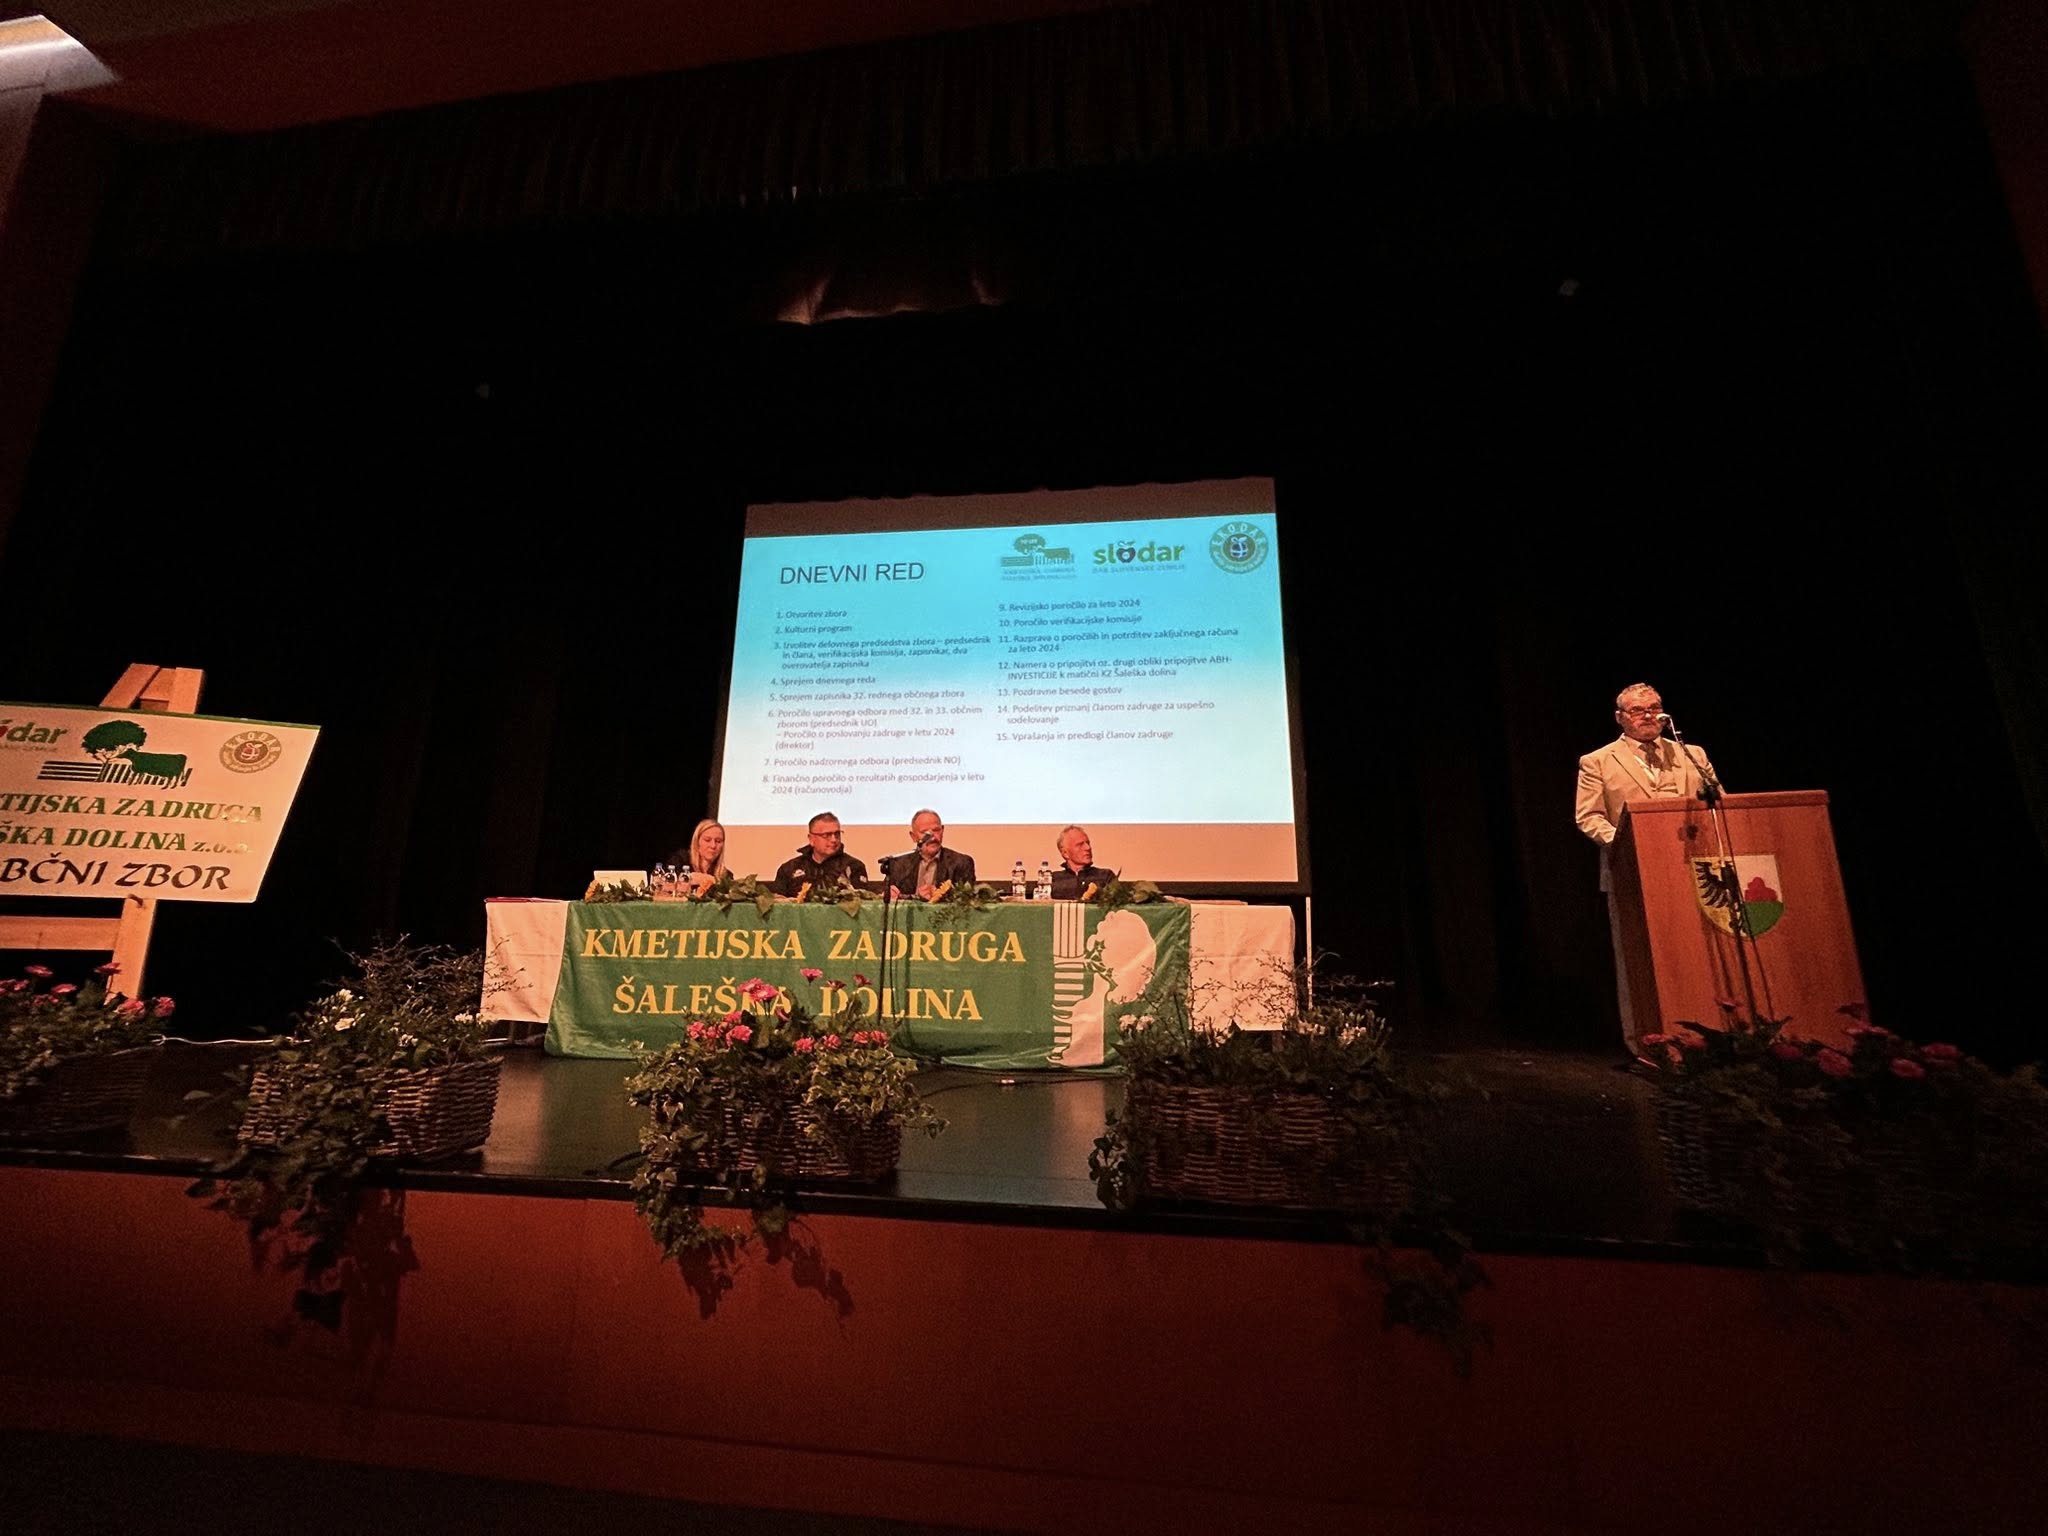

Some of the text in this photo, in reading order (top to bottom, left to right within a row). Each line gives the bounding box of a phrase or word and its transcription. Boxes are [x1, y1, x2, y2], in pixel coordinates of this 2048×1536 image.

[780, 562, 925, 584] DNEVNI RED
[1009, 602, 1049, 611] Revizijsko
[1051, 601, 1086, 610] poročilo
[1099, 600, 1116, 608] leto
[1118, 599, 1141, 607] 2024
[785, 610, 822, 618] Otvoritev
[999, 615, 1142, 627] 10. Poročilo verifikacijske komisije
[784, 626, 816, 634] Kulturni
[818, 626, 852, 634] program
[999, 635, 1012, 643] 11.
[1014, 635, 1052, 643] Razprava
[1061, 633, 1099, 642] poročilih
[1111, 631, 1152, 640] potrditev
[1154, 629, 1205, 638] zaključnega
[1207, 628, 1238, 636] računa
[783, 641, 816, 649] Izvolitev
[818, 640, 859, 649] delovnega
[861, 639, 910, 648] predsedstva
[913, 638, 935, 646] zbora
[944, 636, 991, 645] predsednik
[1038, 644, 1060, 652] 2024
[792, 651, 815, 659] člana,
[818, 650, 868, 658] verifikacijska
[870, 649, 906, 658] komisija,
[908, 647, 950, 656] zapisnikar,
[952, 647, 968, 655] dva
[782, 661, 869, 670] overovatelja zapisnika
[998, 661, 1011, 669] 12.
[1013, 661, 1047, 669] Namera
[1057, 660, 1096, 669] pripojitvi
[1113, 659, 1135, 667] drugi
[1137, 657, 1161, 666] obliki
[1164, 656, 1207, 666] pripojitve
[1209, 656, 1232, 664] ABH-
[1008, 671, 1057, 680] INVESTICIJE
[1067, 670, 1099, 678] matični
[1114, 668, 1146, 677] Šaleška
[1149, 668, 1176, 676] dolina
[780, 678, 814, 686] Sprejem
[815, 677, 855, 685] dnevnega
[857, 676, 876, 684] reda
[780, 693, 812, 702] Sprejem
[814, 692, 851, 701] zapisnika
[853, 692, 866, 700] 32.
[868, 691, 902, 700] rednega
[904, 690, 939, 699] občnega
[941, 690, 965, 698] zbora
[998, 686, 1122, 696] 13. Pozdravne besede gostov
[778, 709, 811, 717] Poročilo
[813, 709, 855, 718] upravnega
[857, 707, 887, 716] odbora
[889, 707, 908, 715] med
[910, 707, 923, 715] 32.
[936, 706, 949, 715] 33.
[950, 705, 982, 714] občnim
[997, 705, 1010, 713] 14.
[1012, 704, 1053, 713] Podelitev
[1055, 703, 1090, 713] priznanj
[1092, 703, 1124, 711] članom
[1126, 702, 1162, 712] zadruge
[1176, 700, 1215, 710] uspešno
[777, 719, 877, 729] zborom (predsednik UO)
[1007, 716, 1059, 725] sodelovanje
[783, 730, 816, 738] Poročilo
[826, 730, 870, 739] poslovanju
[872, 729, 906, 738] zadruge
[914, 728, 931, 736] letu
[933, 728, 955, 736] 2024
[997, 732, 1009, 741] 15.
[1011, 732, 1055, 742] Vprašanja
[1067, 731, 1104, 740] predlogi
[1106, 730, 1135, 739] članov
[1138, 730, 1174, 740] zadruge
[775, 741, 814, 751] (direktor)
[774, 758, 807, 767] Poročilo
[809, 757, 857, 767] nadzornega
[859, 757, 889, 766] odbora
[891, 756, 942, 766] (predsednik
[944, 756, 961, 766] NO)
[773, 774, 810, 782] Finančno
[812, 774, 846, 783] poročilo
[856, 773, 895, 782] rezultatih
[898, 773, 958, 783] gospodarjenja
[968, 772, 985, 781] letu
[772, 785, 852, 795] 2024 (računovodja)
[62, 827, 186, 851] DOLINA
[0, 852, 231, 891] BČNI ZBOR
[580, 928, 1027, 962] KMETIJSKA ZADRUGA
[818, 986, 983, 1020] DOLINA
